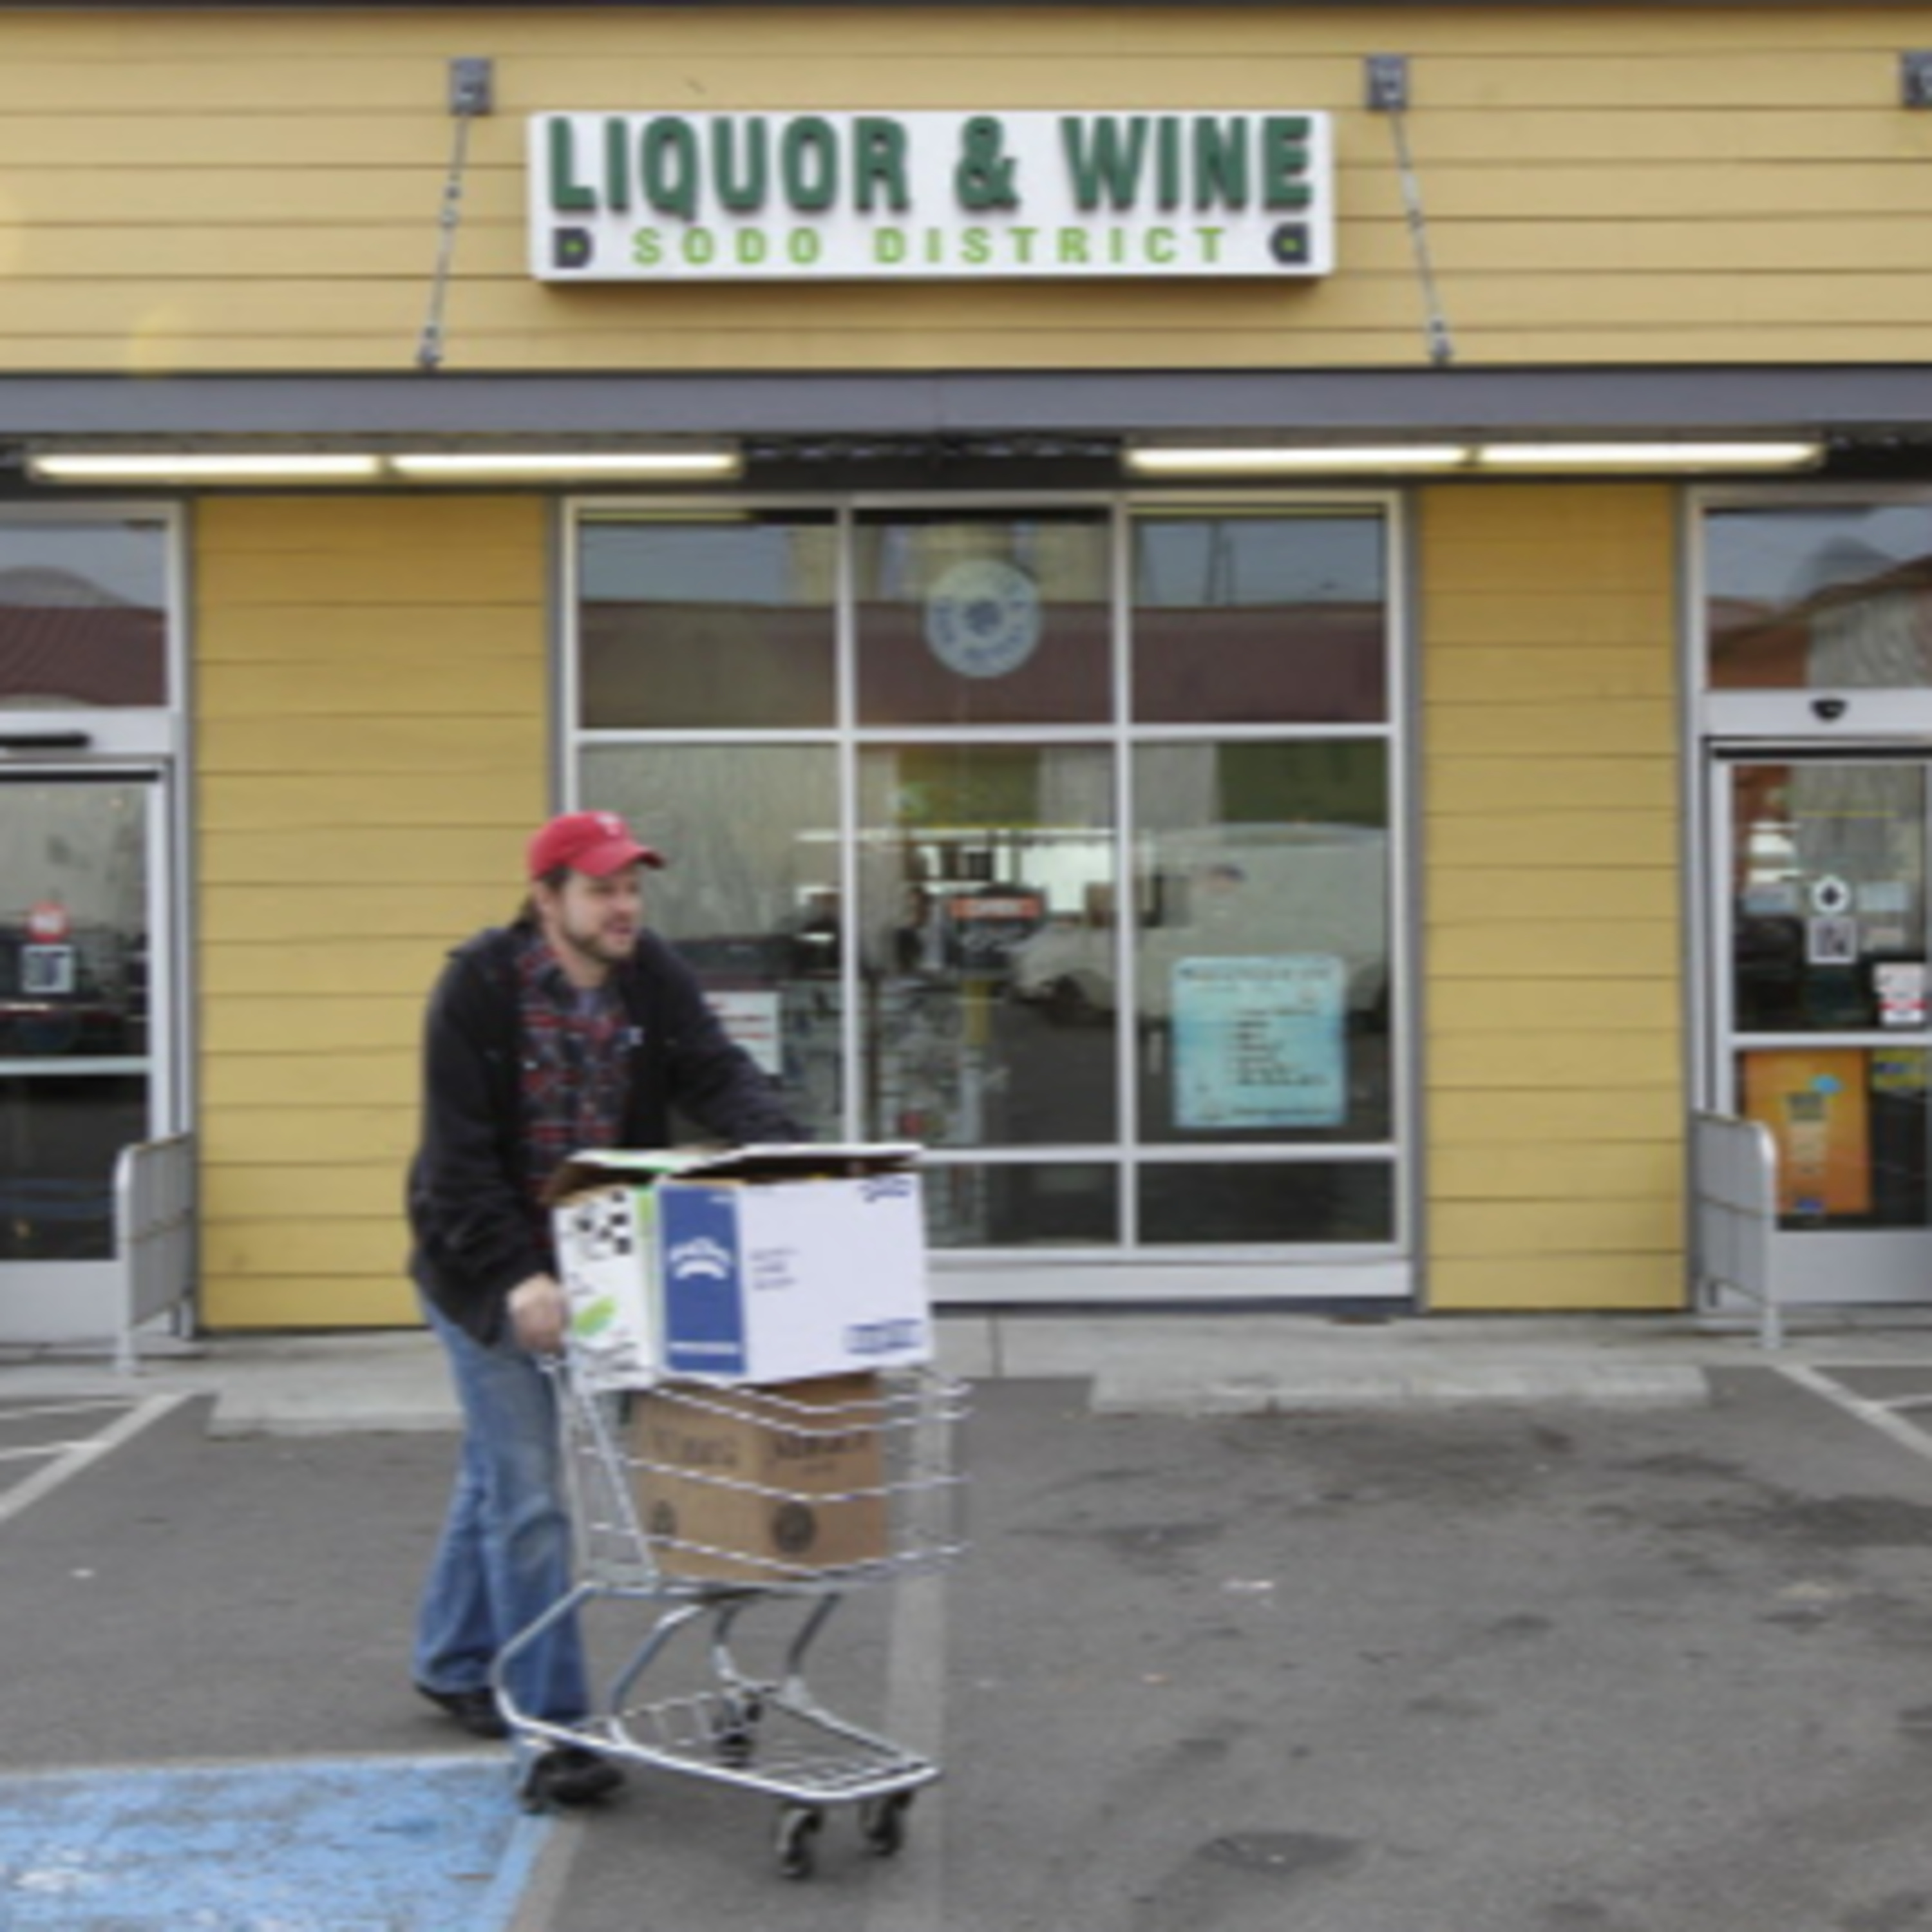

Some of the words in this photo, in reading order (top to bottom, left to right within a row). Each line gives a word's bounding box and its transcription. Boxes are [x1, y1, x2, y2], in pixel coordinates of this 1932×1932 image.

[548, 115, 911, 222] LIQUOR
[954, 115, 1020, 215] &
[1059, 115, 1313, 214] WINE
[632, 227, 821, 265] SODO
[875, 225, 1225, 265] DISTRICT
